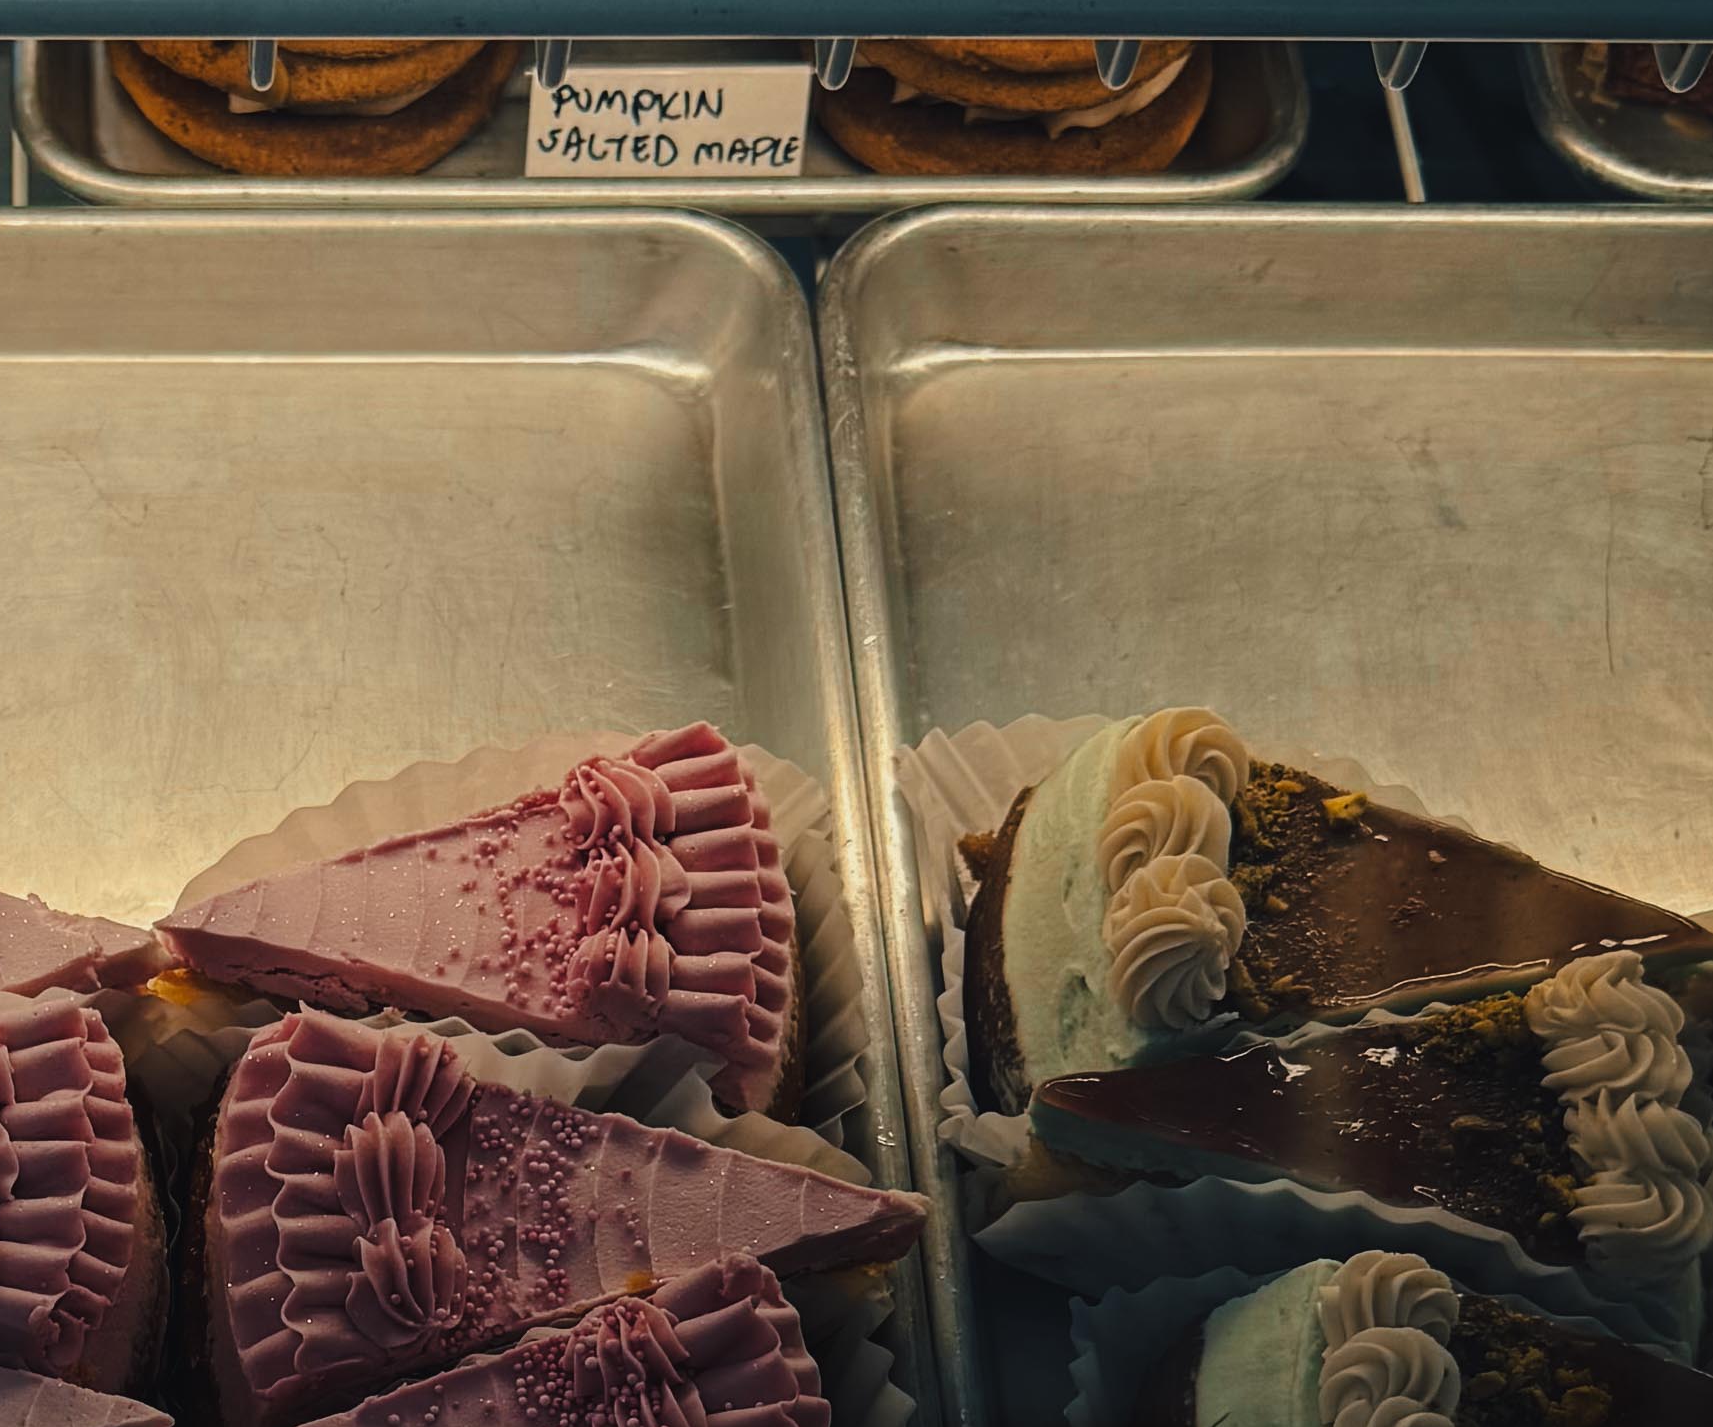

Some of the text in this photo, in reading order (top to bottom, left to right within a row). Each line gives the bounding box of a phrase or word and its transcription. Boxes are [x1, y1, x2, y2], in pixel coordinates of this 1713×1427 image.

[551, 84, 724, 125] PUMPKIN
[537, 126, 803, 167] SALTED MAPLE
